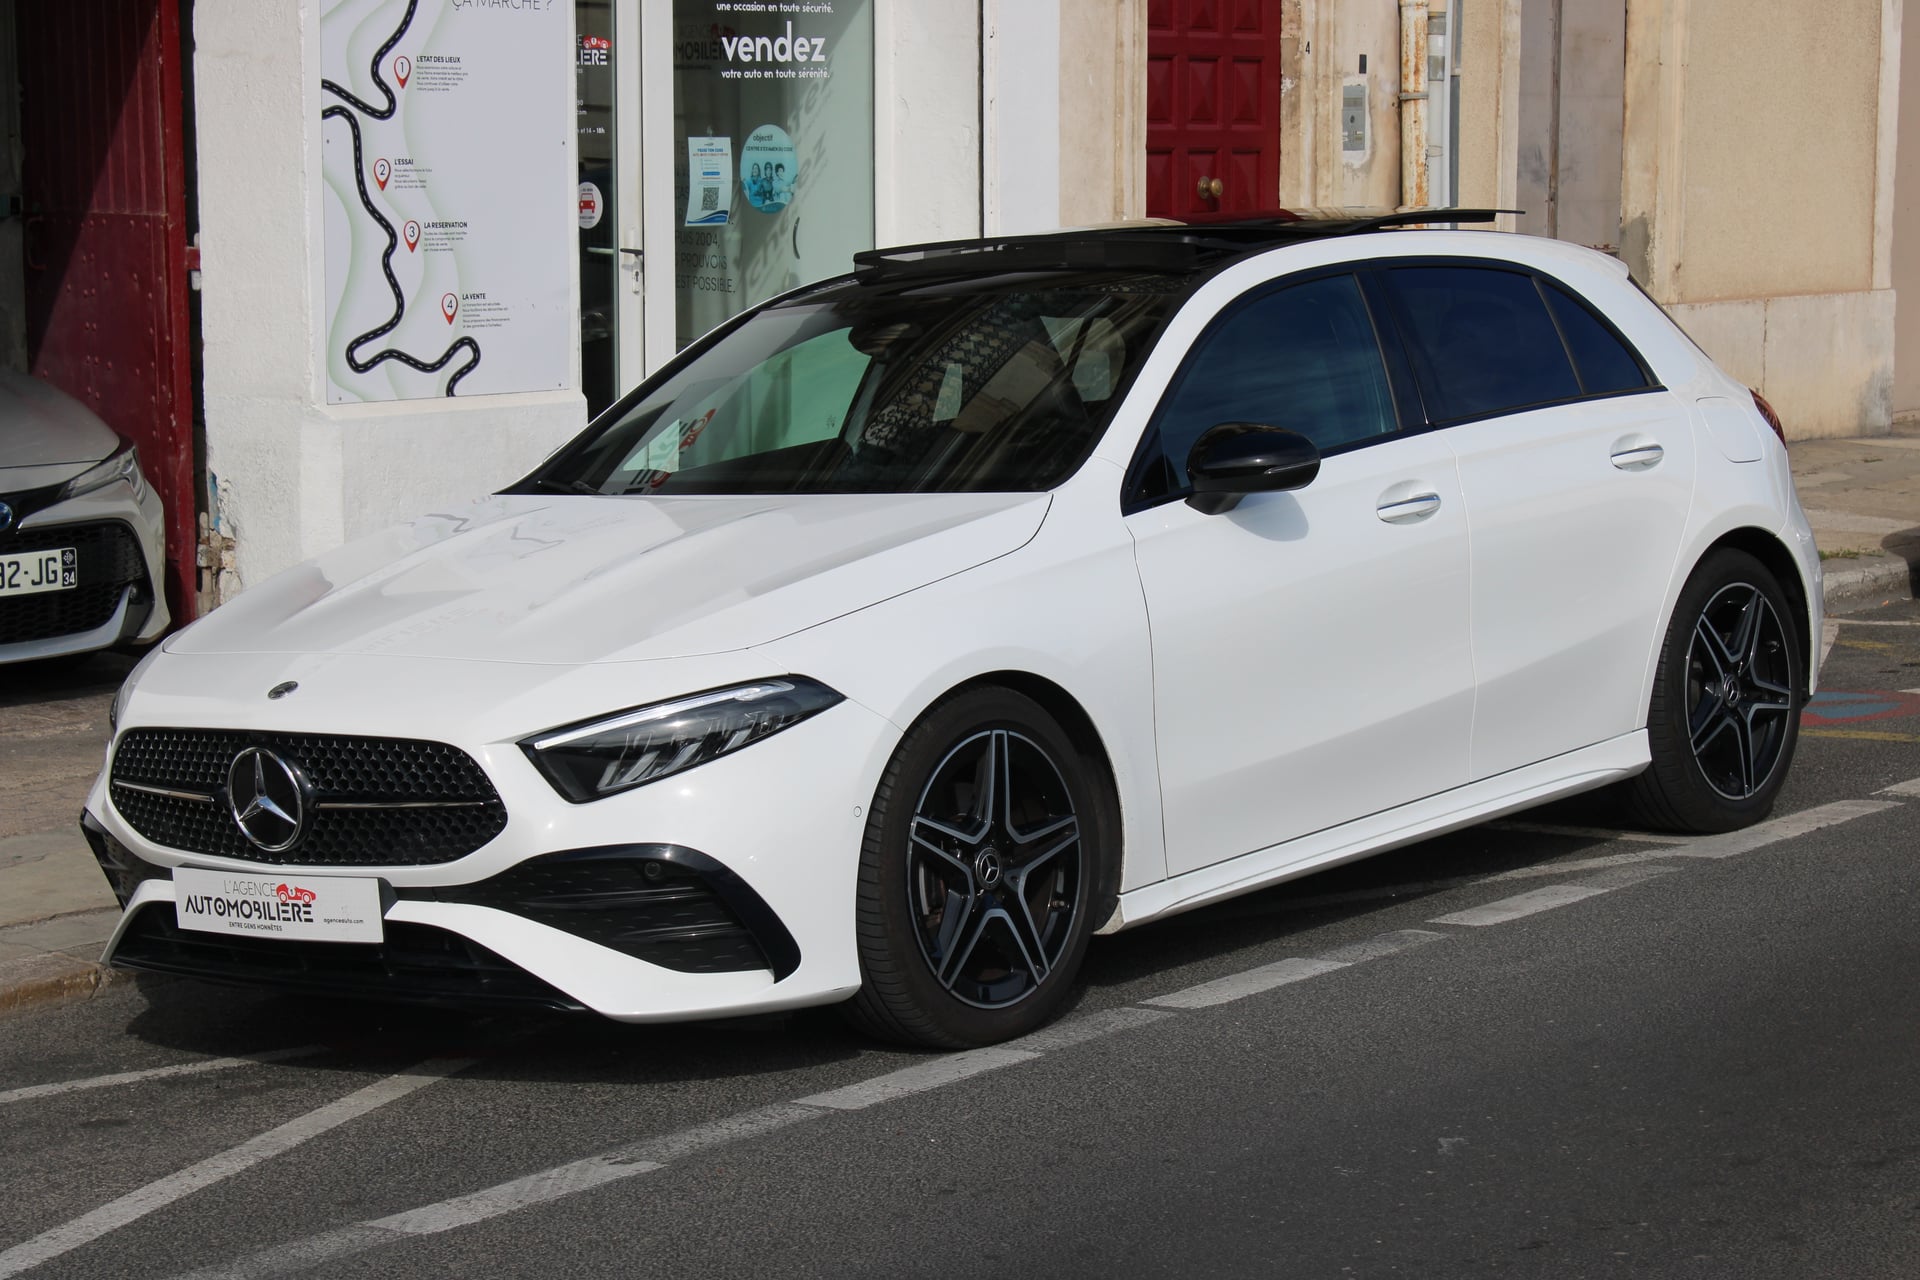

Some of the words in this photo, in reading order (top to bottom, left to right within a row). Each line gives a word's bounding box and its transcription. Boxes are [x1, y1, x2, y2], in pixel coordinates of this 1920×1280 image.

[476, 0, 541, 10] MARCHE
[716, 2, 731, 11] une
[733, 1, 766, 12] occasion
[768, 4, 778, 12] en
[780, 3, 800, 13] toute
[802, 2, 834, 13] sécurité.
[721, 20, 826, 62] vendez
[1305, 40, 1310, 55] 4
[399, 62, 404, 73] 1
[721, 69, 742, 79] votre
[744, 69, 762, 79] auto
[764, 71, 773, 79] en
[776, 69, 796, 79] toute
[798, 67, 830, 79] sérénité.
[753, 134, 774, 143] objectif
[379, 164, 386, 176] 2
[409, 226, 415, 238] 3
[446, 299, 453, 310] 4
[63, 571, 75, 585] 34
[223, 880, 277, 897] L'AGENCE
[229, 921, 243, 929] ENTRE
